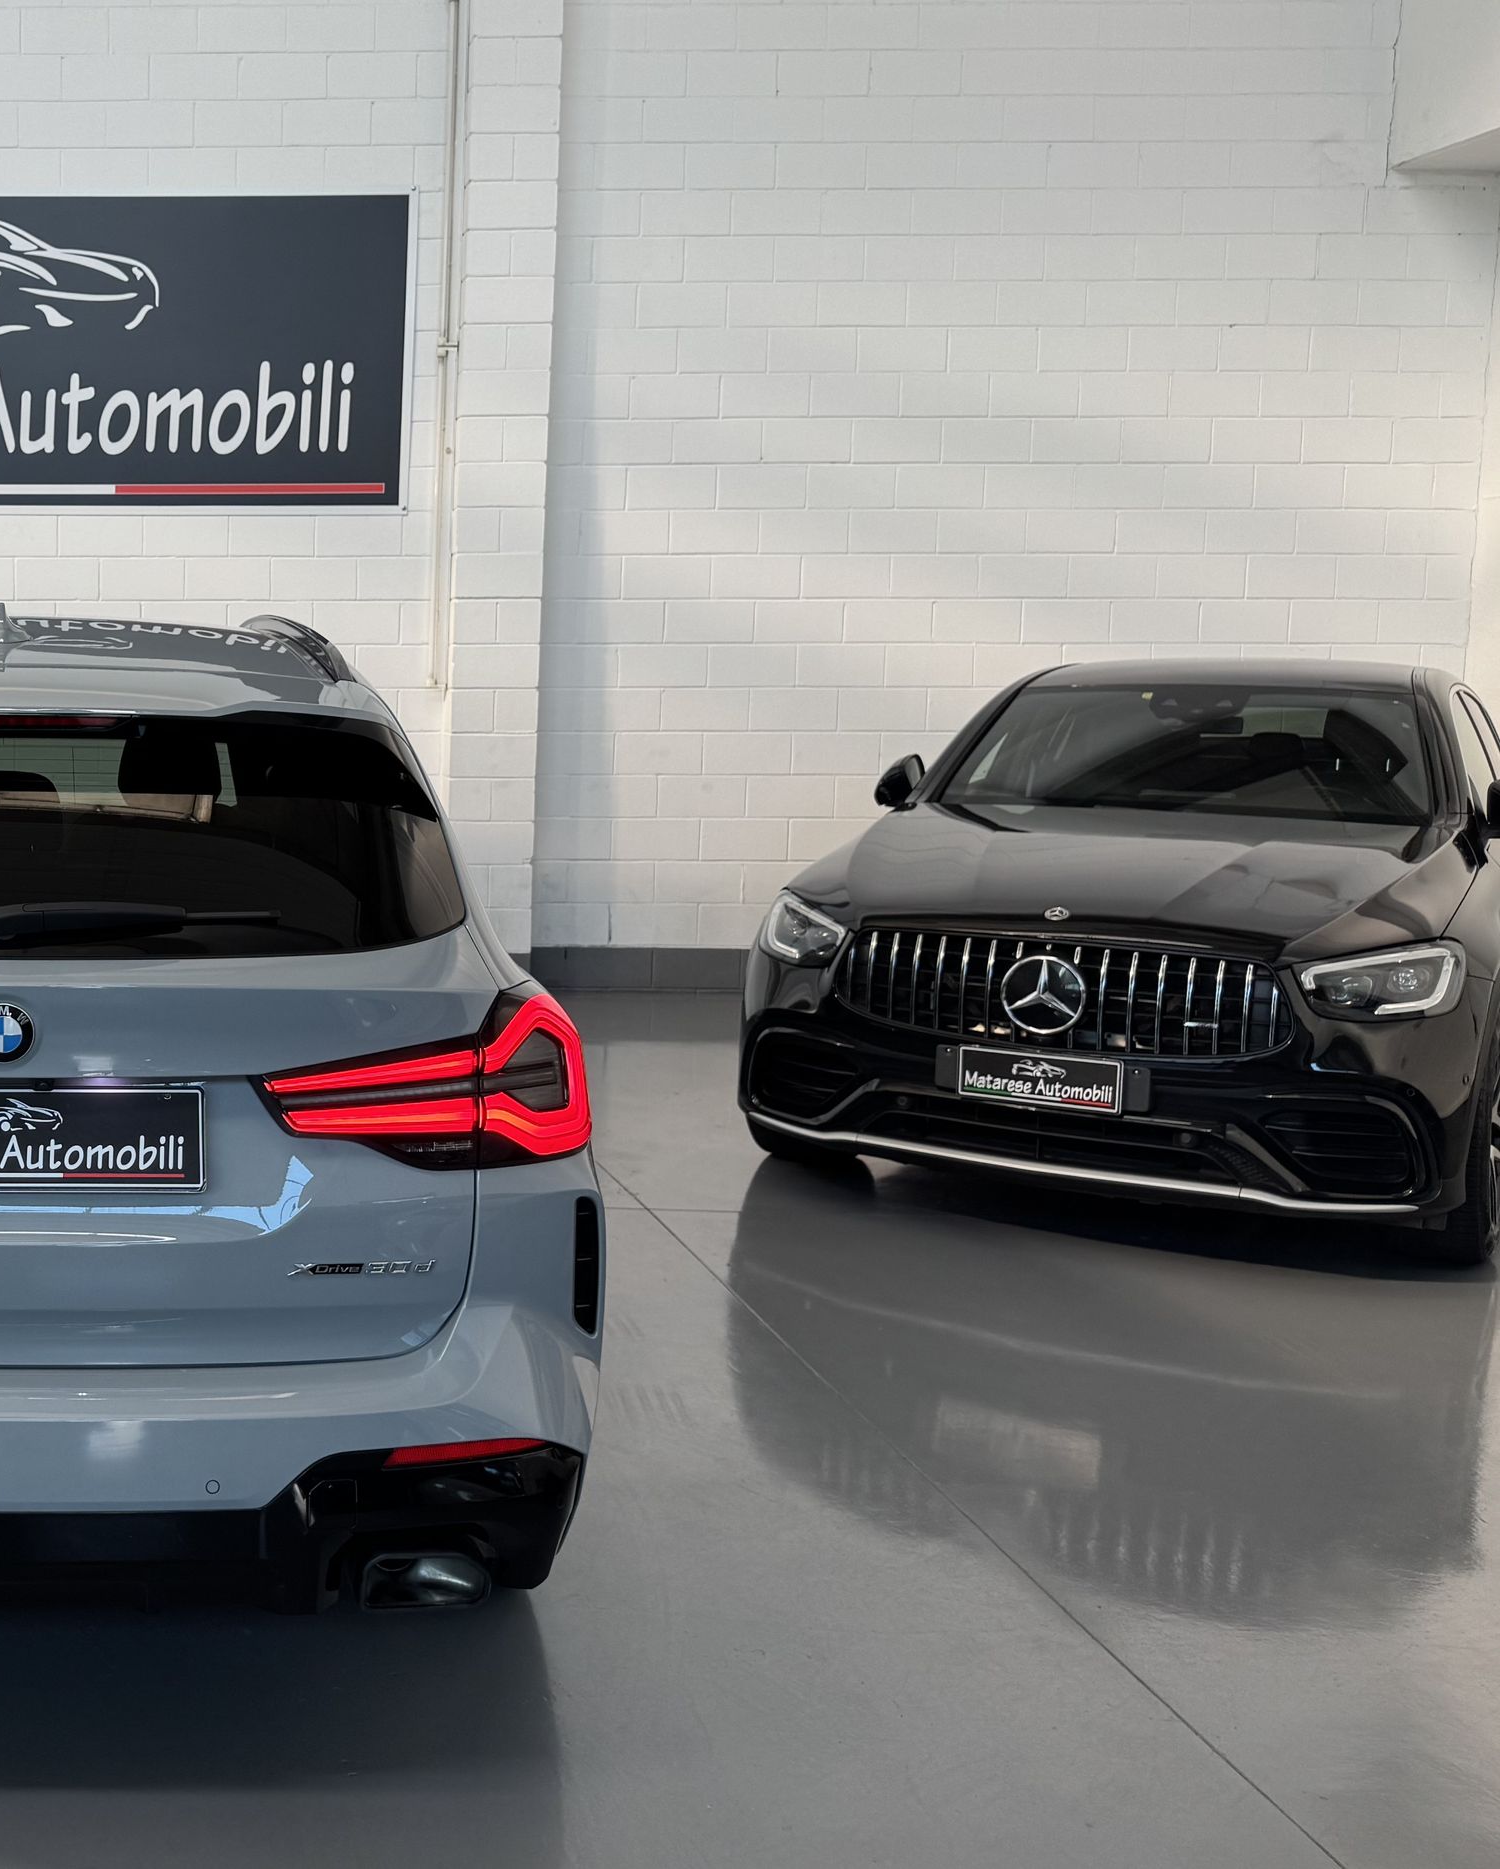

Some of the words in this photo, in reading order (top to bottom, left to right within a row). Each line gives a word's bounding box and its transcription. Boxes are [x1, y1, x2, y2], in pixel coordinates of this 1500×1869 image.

[964, 1069, 1032, 1093] Matarese
[1034, 1078, 1113, 1103] Automobili
[0, 1133, 185, 1171] Automobili
